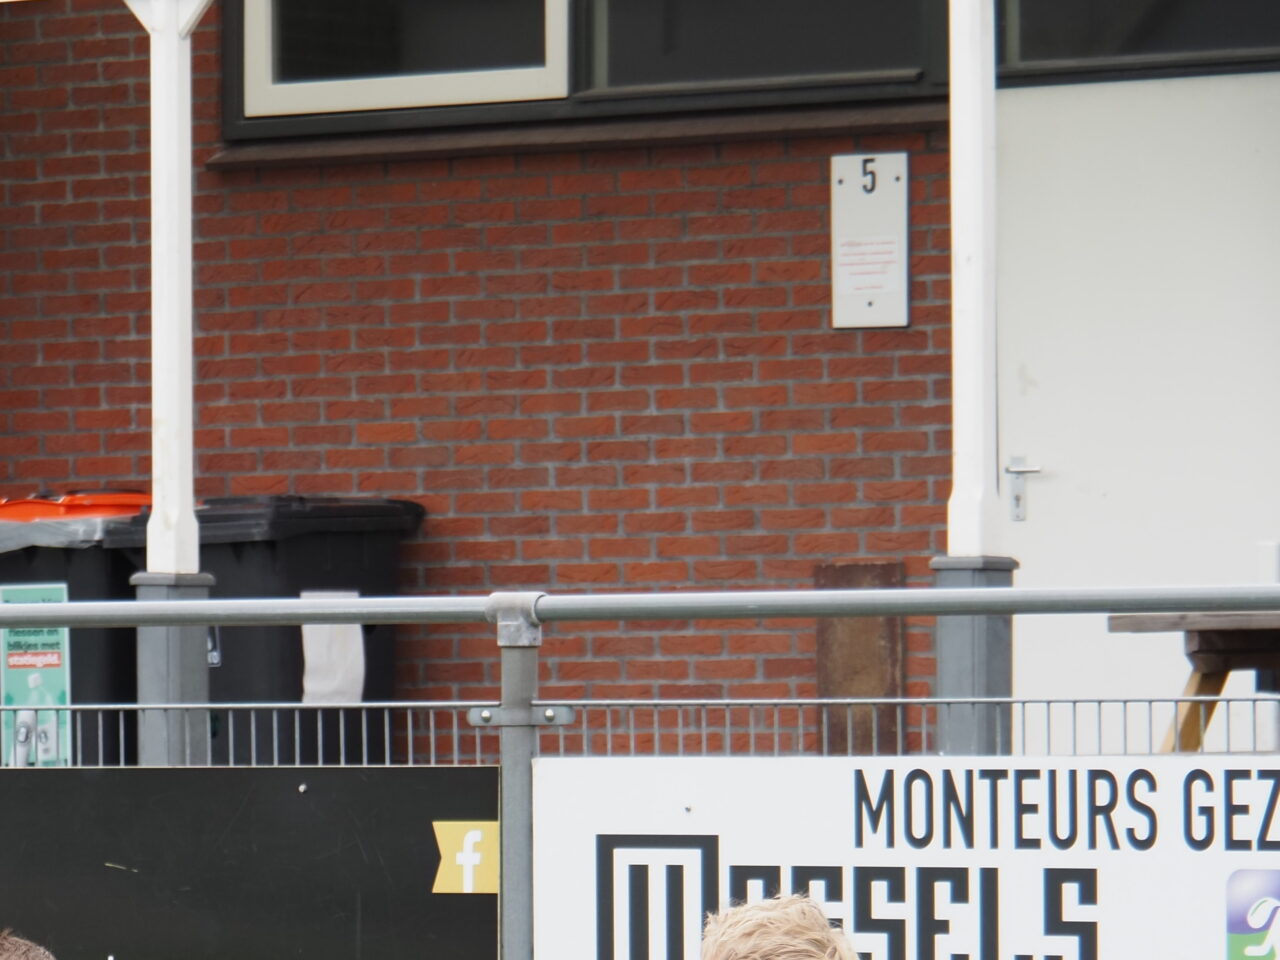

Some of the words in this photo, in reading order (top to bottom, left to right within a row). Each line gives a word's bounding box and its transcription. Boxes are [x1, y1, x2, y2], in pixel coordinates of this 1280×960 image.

[862, 158, 876, 194] 5
[855, 768, 1158, 851] MONTEURS
[1183, 768, 1280, 851] GEZ
